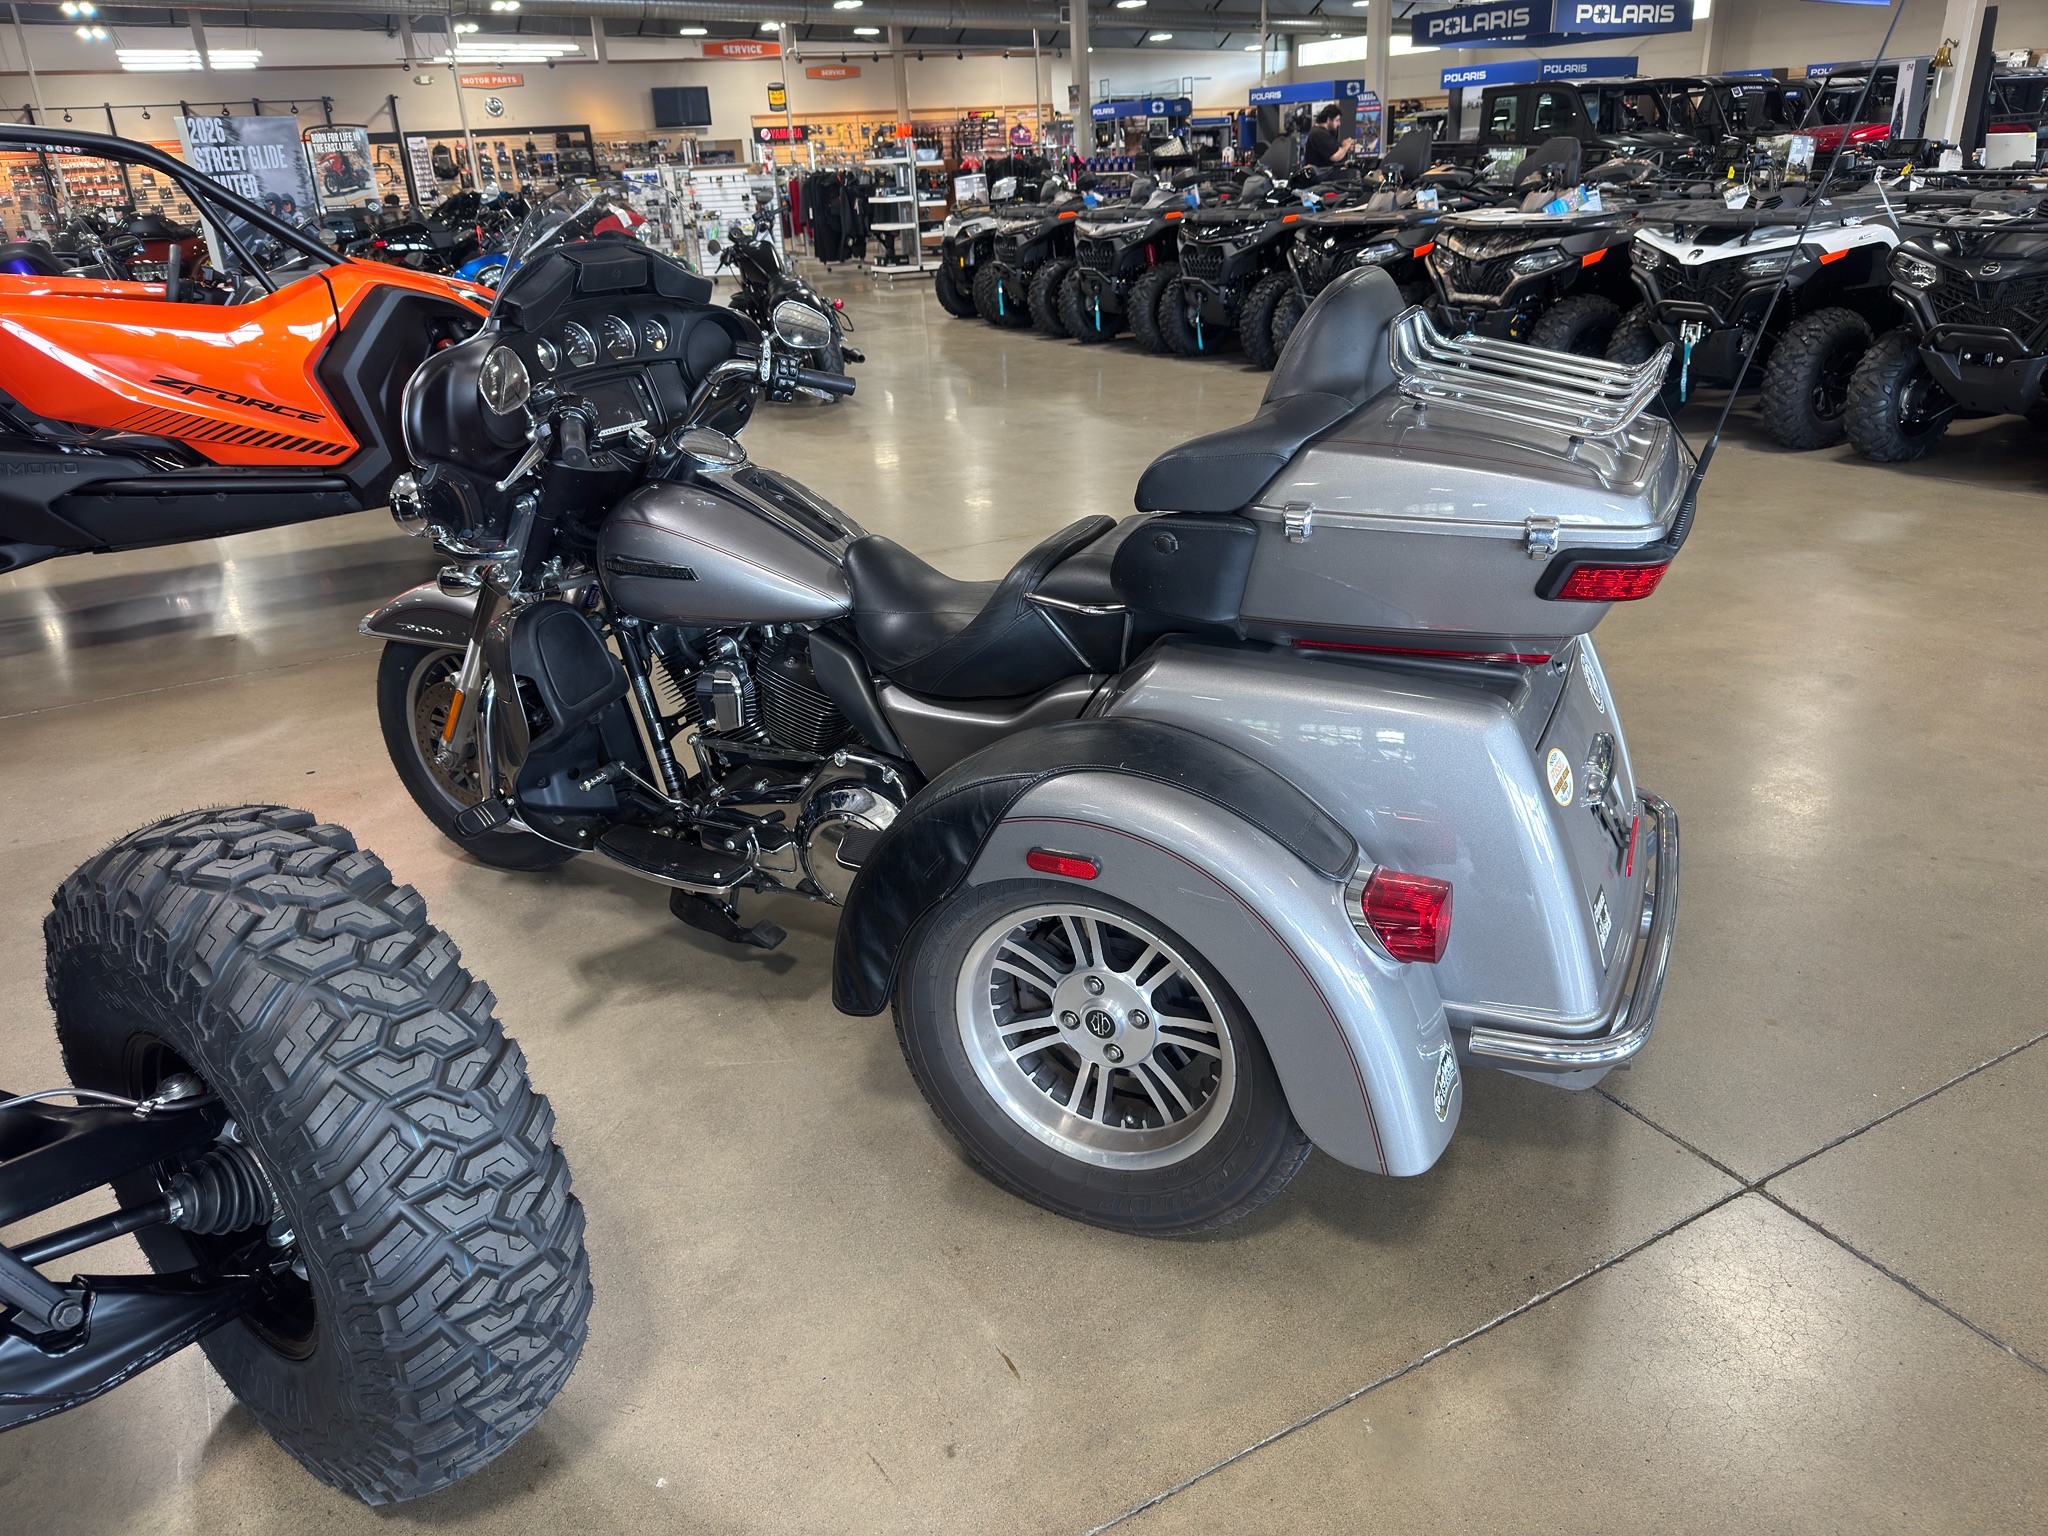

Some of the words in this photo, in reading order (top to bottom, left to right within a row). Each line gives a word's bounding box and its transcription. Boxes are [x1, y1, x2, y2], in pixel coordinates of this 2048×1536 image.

[1575, 4, 1675, 24] POLARIS
[1428, 7, 1530, 38] POLARIS
[723, 45, 763, 54] SERVICE
[1543, 64, 1587, 74] POLARIS
[462, 77, 490, 85] MOTOR
[491, 76, 517, 84] PARTS
[1443, 71, 1487, 83] POLARIS
[1251, 91, 1282, 101] POLARIS
[1093, 107, 1115, 116] POLARIS
[187, 117, 226, 144] 2026
[310, 133, 326, 143] BORN
[327, 132, 340, 142] FOR
[340, 132, 353, 142] LIFE
[352, 131, 361, 141] IN
[312, 143, 324, 153] THE
[193, 146, 247, 173] STREET
[247, 144, 288, 170] GLIDE
[149, 374, 326, 424] ZFORCE
